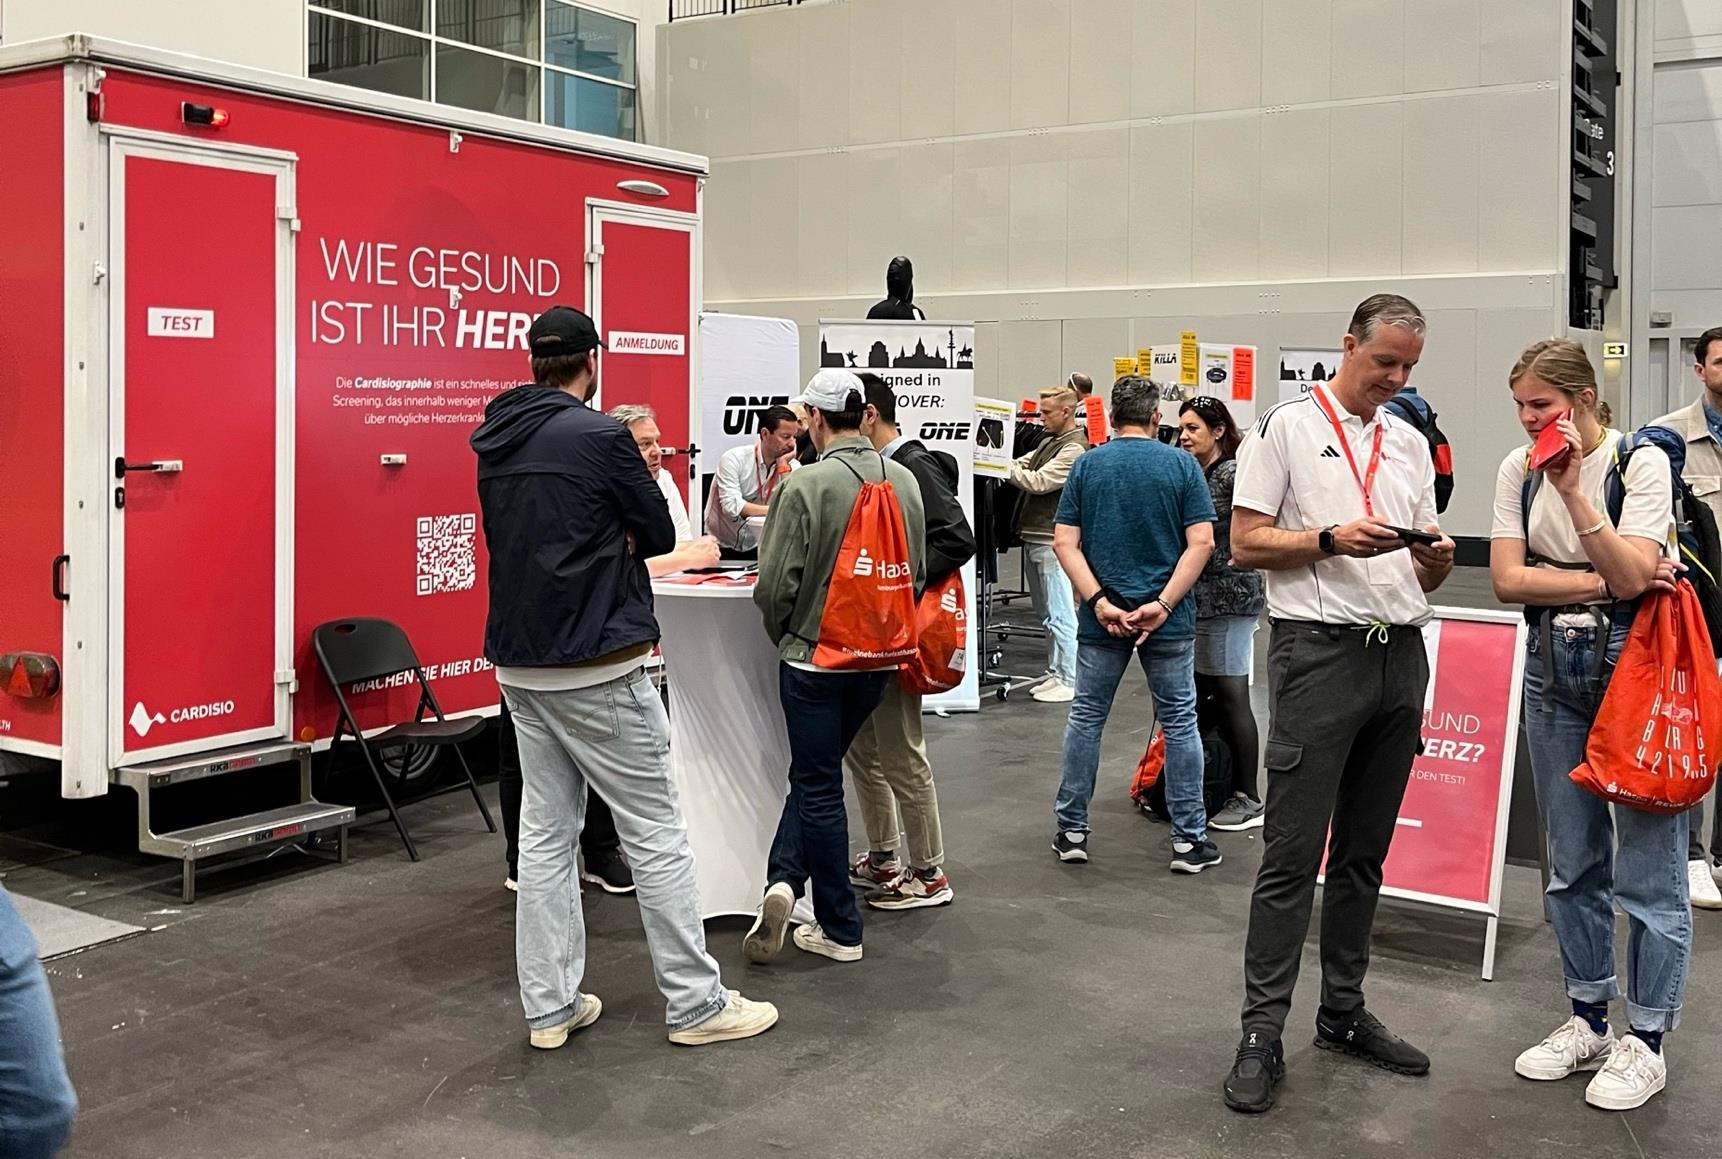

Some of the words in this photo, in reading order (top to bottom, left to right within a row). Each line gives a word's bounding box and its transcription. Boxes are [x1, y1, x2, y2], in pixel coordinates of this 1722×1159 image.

[1606, 150, 1615, 176] 3
[319, 237, 398, 286] WIE
[408, 246, 561, 297] GESUND
[160, 315, 203, 332] TEST
[311, 300, 373, 345] IST
[383, 303, 446, 348] IHR
[455, 308, 542, 351] HER
[615, 336, 679, 351] ANMELDUNG
[335, 376, 353, 389] Die
[354, 376, 433, 391] Cardisiographie
[433, 378, 445, 389] ist
[446, 378, 460, 389] ein
[460, 379, 499, 390] schnelles
[500, 379, 517, 390] und
[880, 373, 922, 390] igned
[927, 373, 941, 387] in
[1300, 384, 1313, 393] De
[332, 395, 384, 409] Screening,
[385, 395, 403, 407] das
[403, 395, 446, 407] innerhalb
[447, 396, 481, 409] weniger
[894, 394, 945, 409] OVER:
[364, 413, 387, 425] über
[388, 413, 430, 426] mögliche
[919, 422, 971, 441] ONE
[351, 668, 415, 695] MACHEN
[440, 659, 472, 679] HIER
[473, 656, 494, 673] DE
[170, 700, 235, 723] CARDISIO
[1421, 737, 1486, 763] ERZ?
[1416, 770, 1438, 781] DEN
[1439, 773, 1466, 785] TEST!
